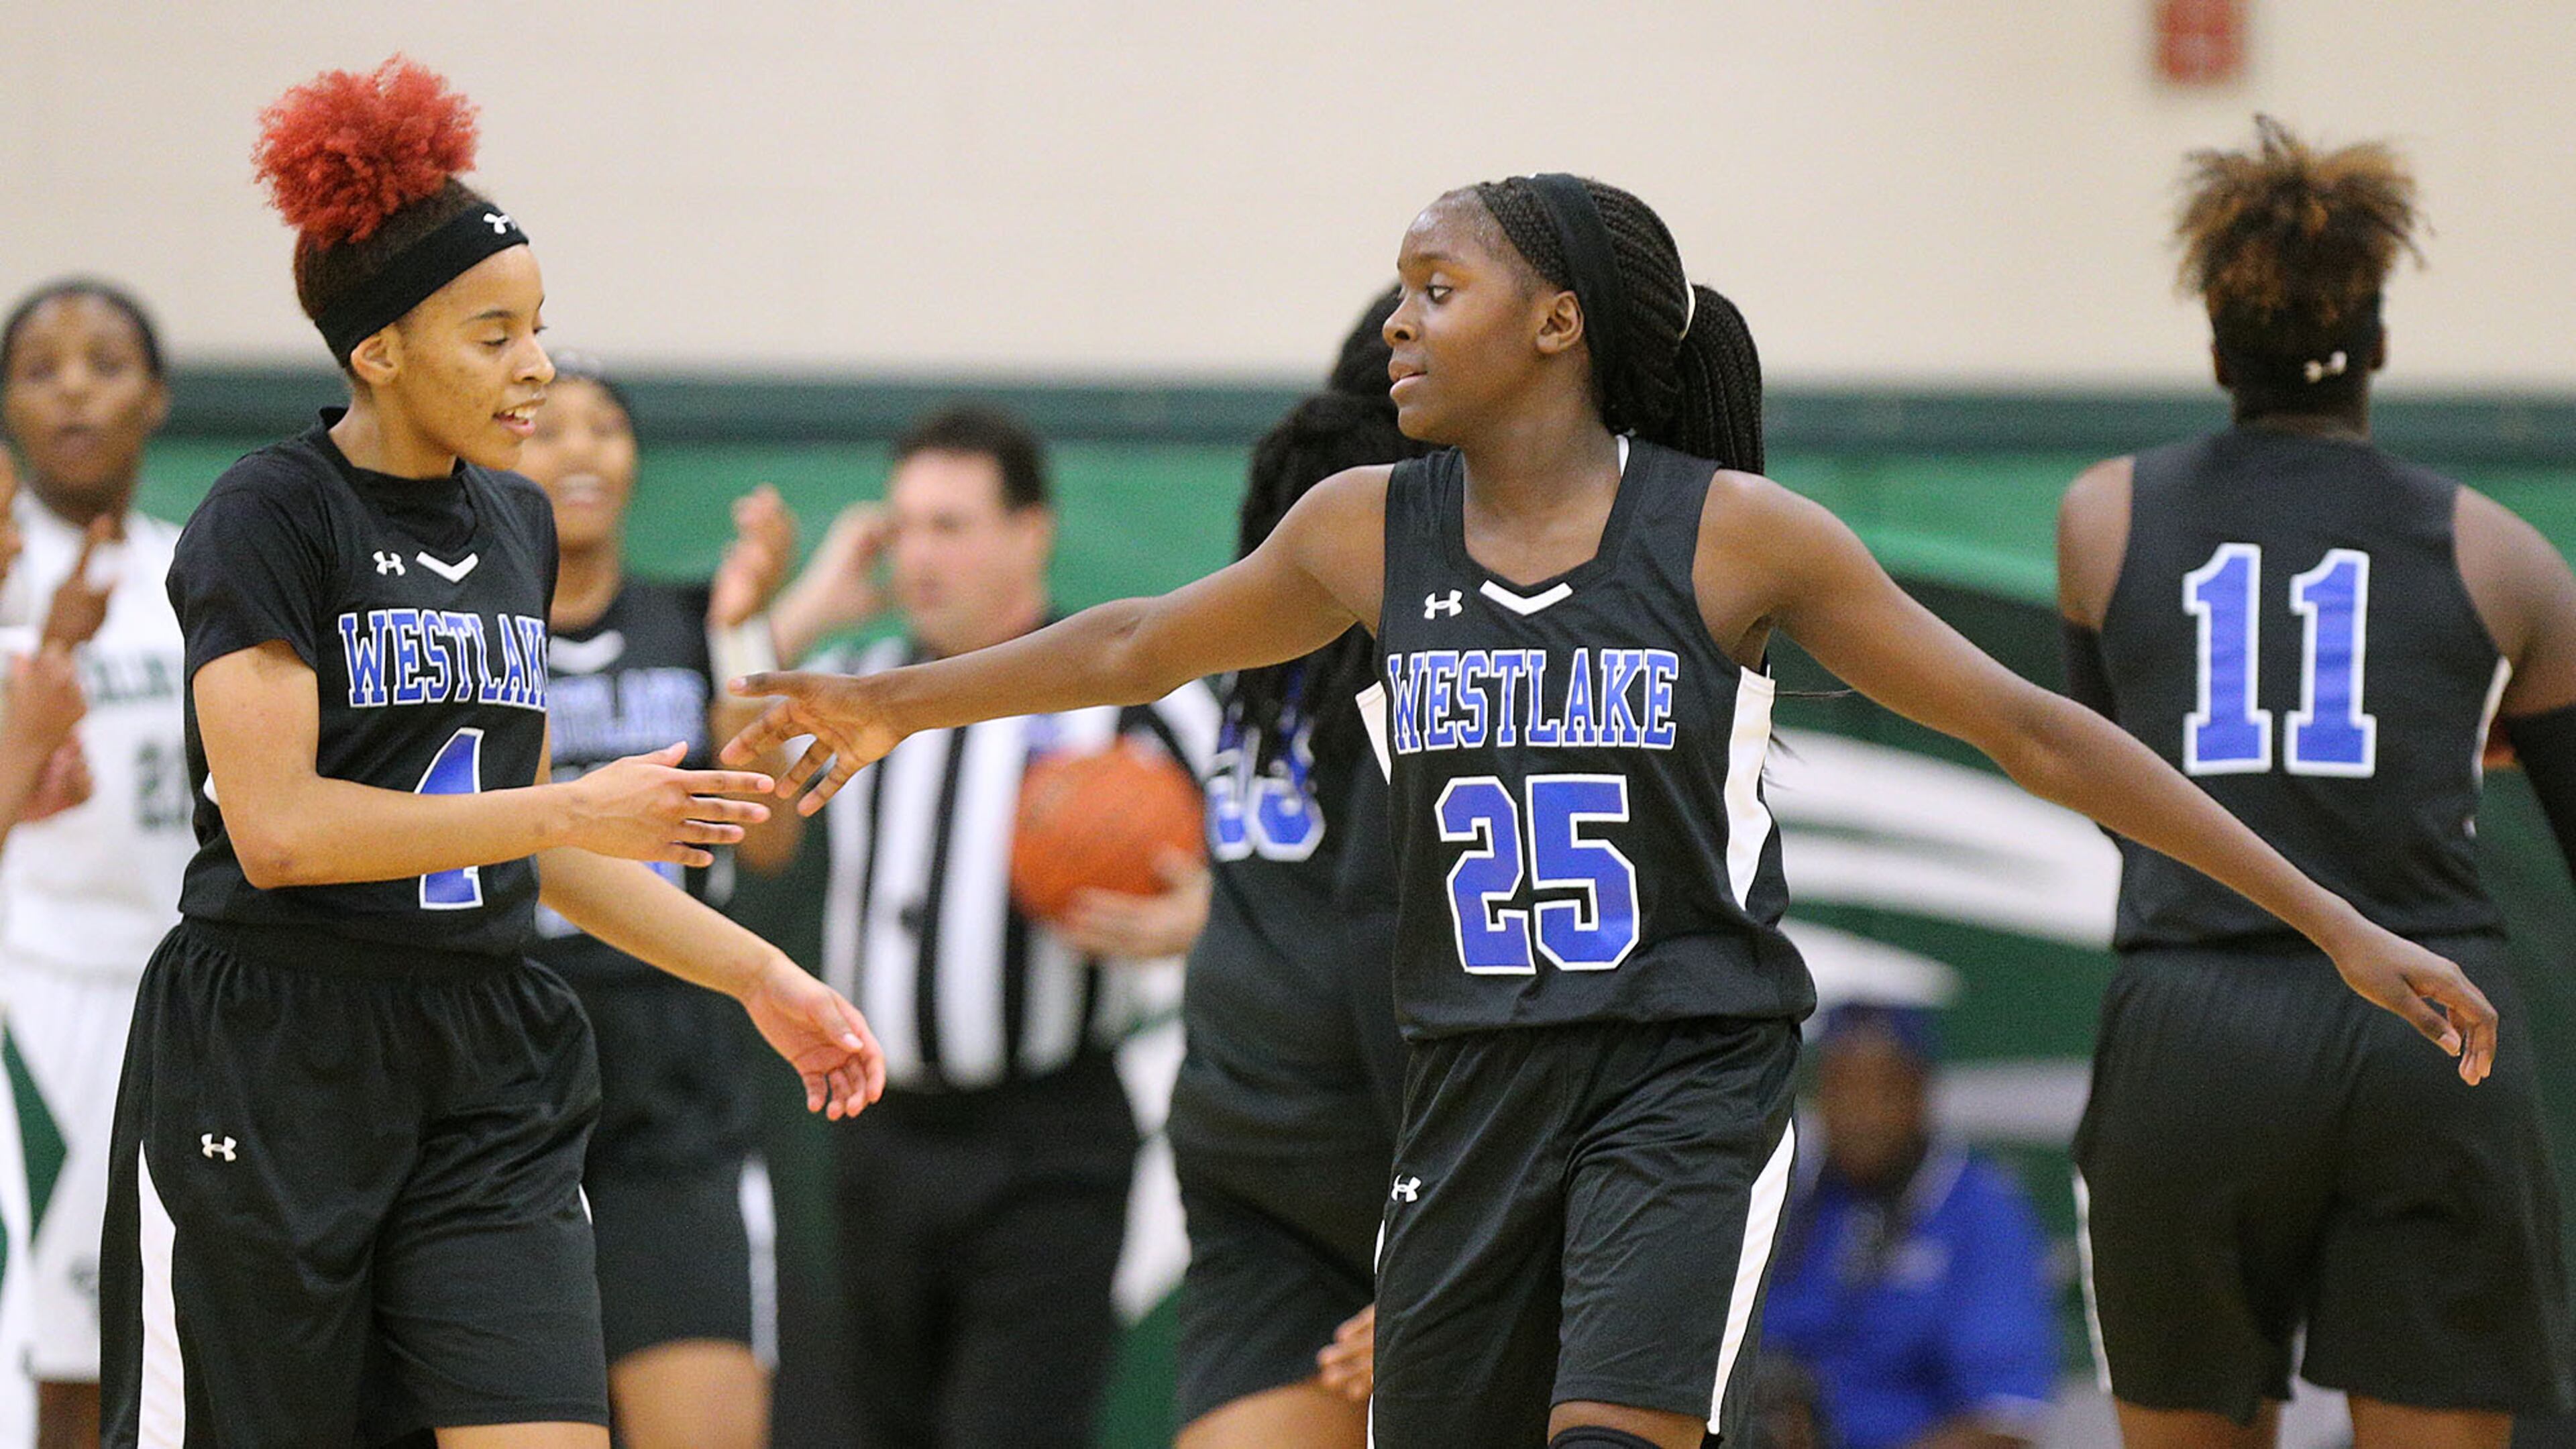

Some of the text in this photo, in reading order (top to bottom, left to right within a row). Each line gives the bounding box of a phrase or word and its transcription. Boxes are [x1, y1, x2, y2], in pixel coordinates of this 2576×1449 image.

[338, 608, 548, 712] WESTLAK
[1388, 647, 1678, 755] WESTLAKE
[2182, 542, 2377, 778] 11
[1435, 773, 1640, 975] 25
